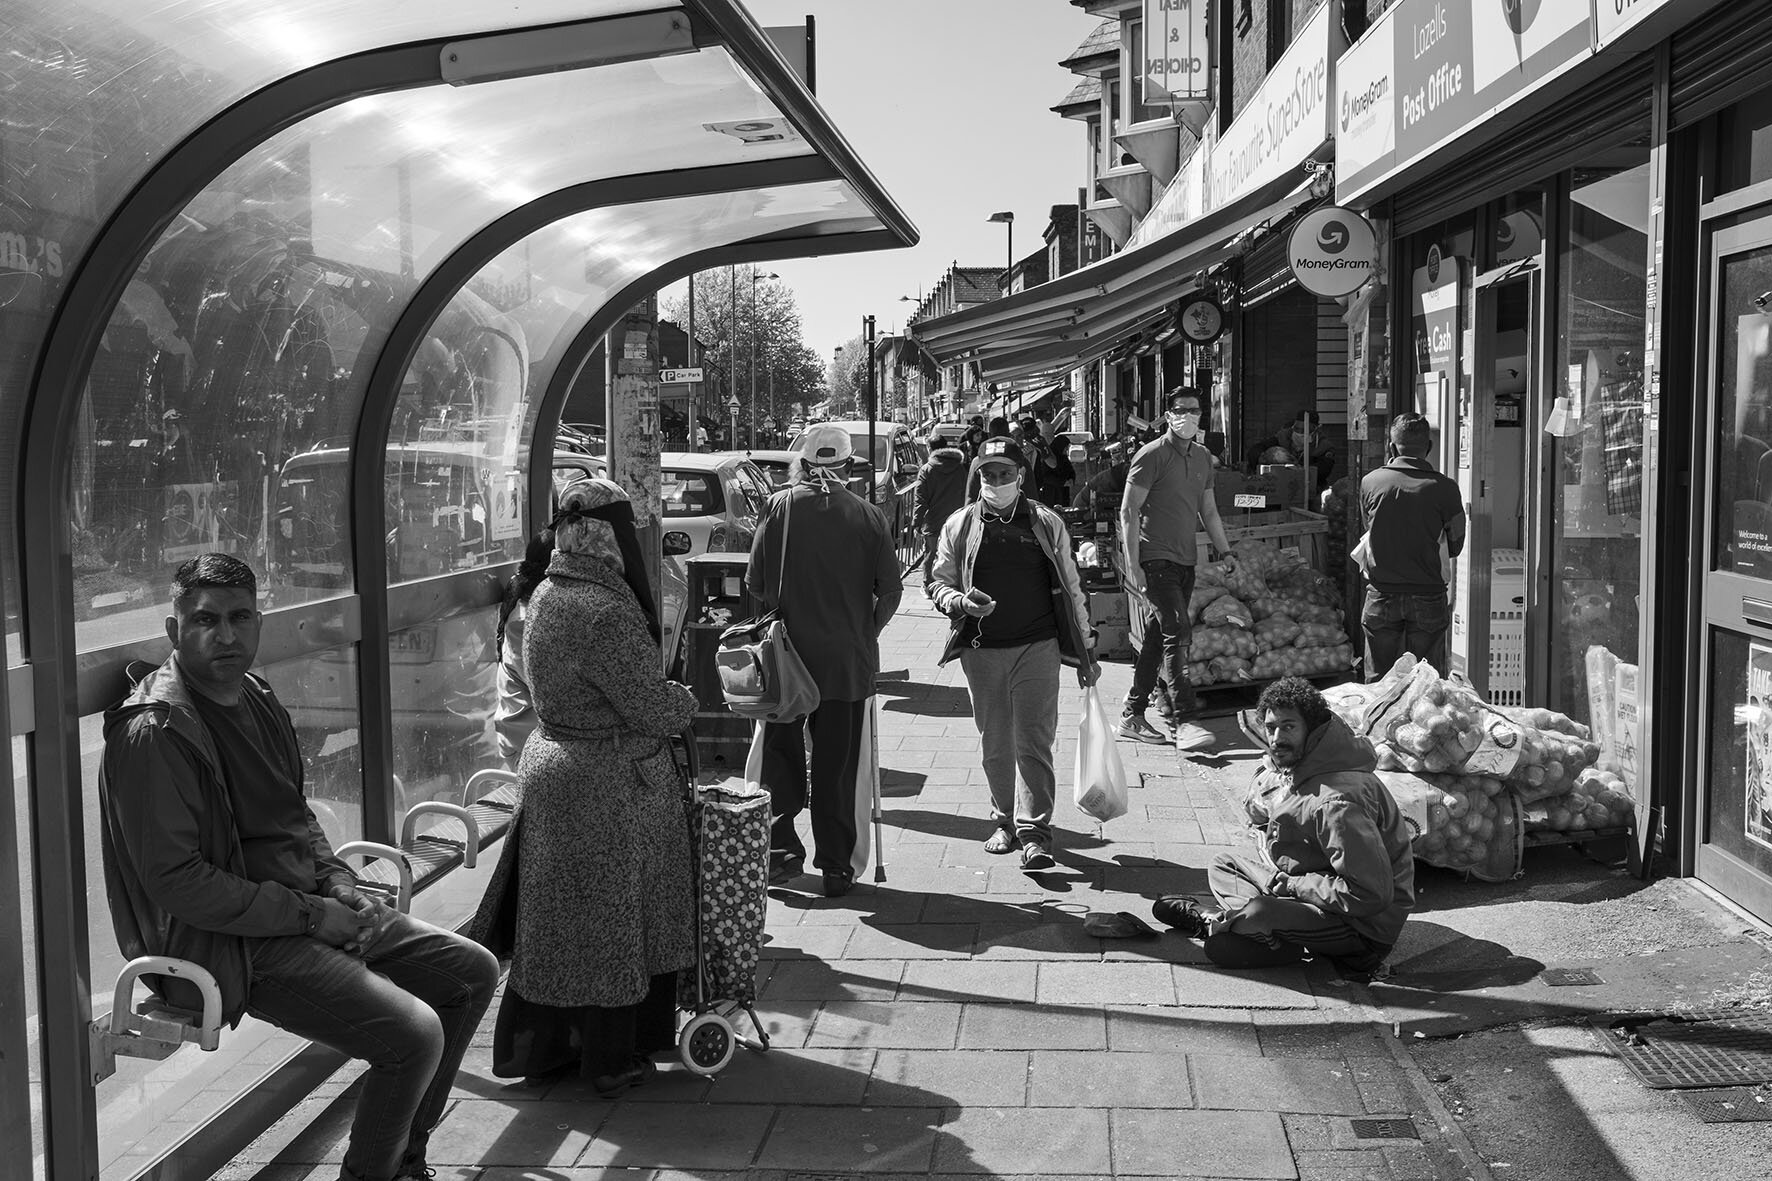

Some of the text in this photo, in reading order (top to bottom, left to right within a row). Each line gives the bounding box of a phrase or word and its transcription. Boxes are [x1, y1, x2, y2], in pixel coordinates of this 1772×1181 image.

[1413, 2, 1447, 60] Lozells
[1266, 56, 1325, 162] SuperStore
[1351, 75, 1388, 120] MoneyGram
[1402, 86, 1425, 131] Post
[1428, 61, 1462, 111] Office
[1296, 258, 1369, 271] MoneyGram
[1432, 321, 1451, 353] Cash
[1738, 541, 1751, 549] world
[1752, 542, 1757, 550] of
[1739, 530, 1759, 539] Welcome
